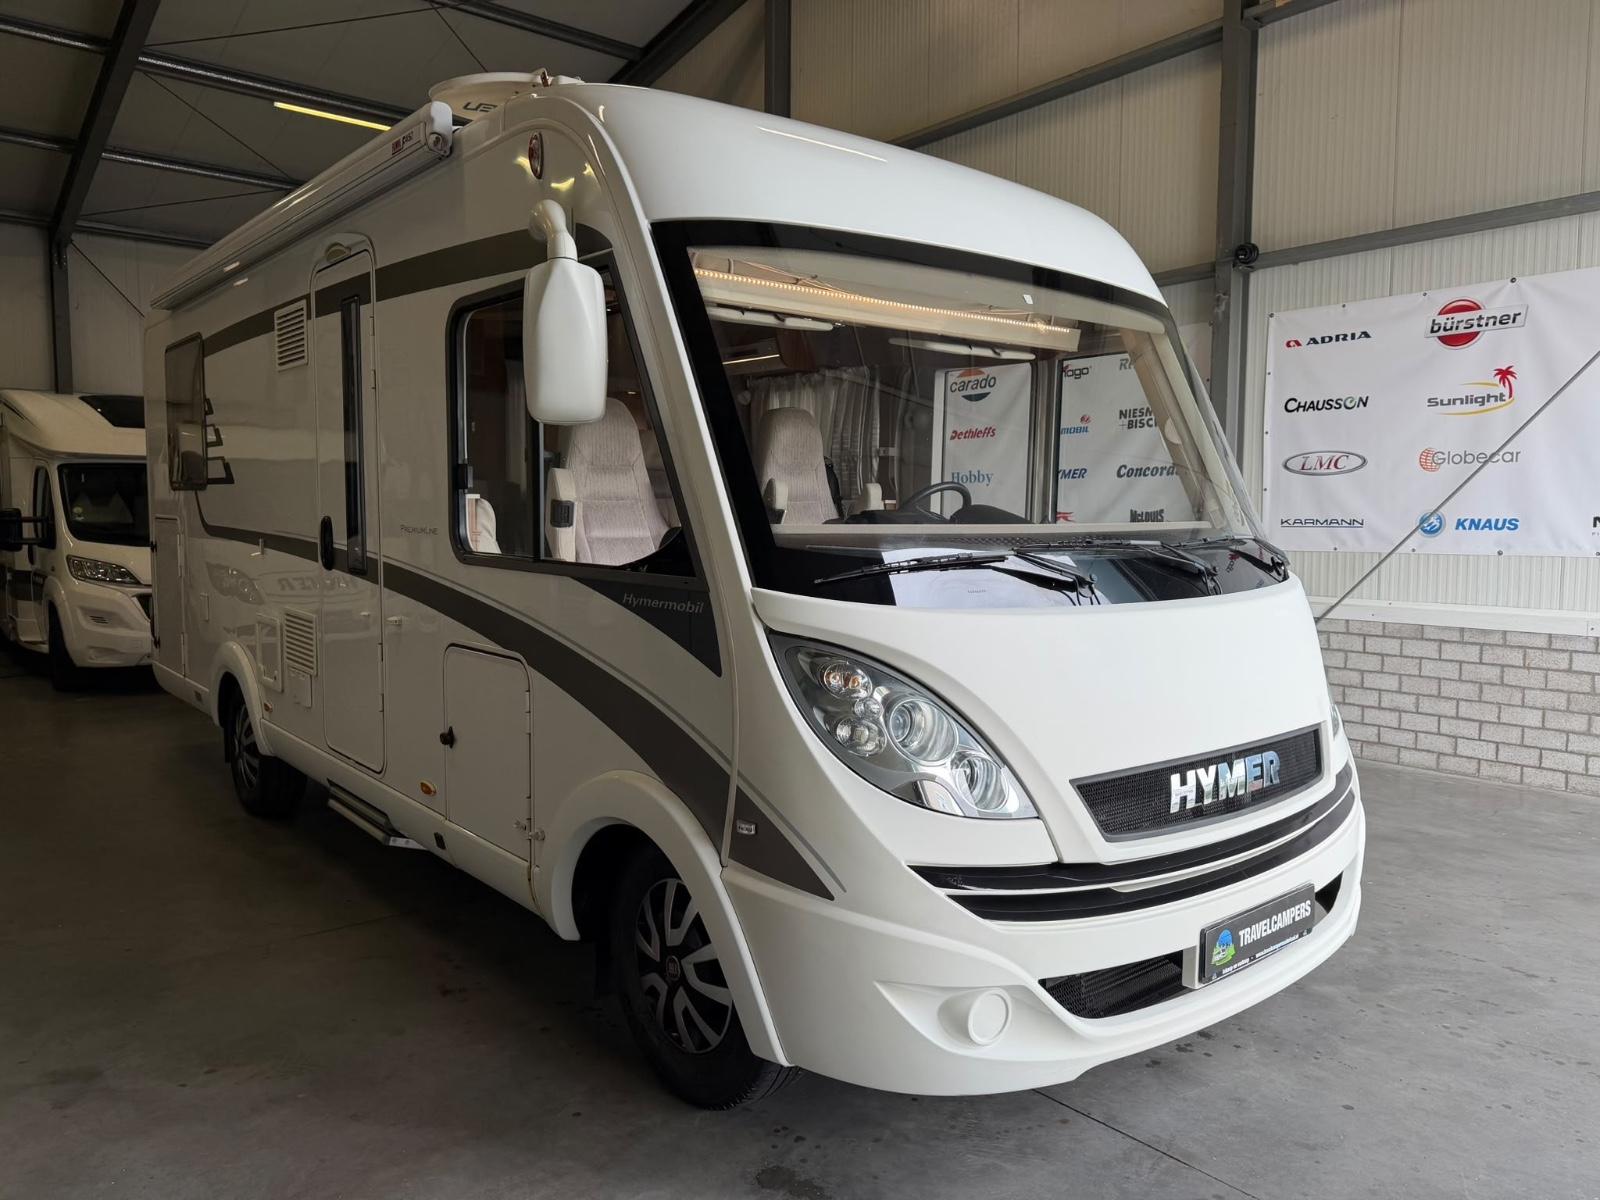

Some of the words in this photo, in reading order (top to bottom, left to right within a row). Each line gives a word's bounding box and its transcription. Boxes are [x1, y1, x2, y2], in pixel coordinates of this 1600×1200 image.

[1430, 310, 1522, 335] bürstner
[1306, 330, 1372, 346] ADRIA
[949, 374, 997, 394] carado
[1427, 391, 1506, 409] Sunlight
[950, 427, 997, 440] Dethleffs
[1300, 454, 1349, 471] LMC
[1431, 449, 1521, 466] Globecar
[951, 470, 995, 486] Hobby
[1280, 518, 1364, 527] KARMANN
[1455, 517, 1520, 532] KNAUS
[622, 592, 704, 615] Hymermobil
[1170, 751, 1280, 813] HYMER
[1239, 900, 1311, 947] TRAVELCAMPERS
